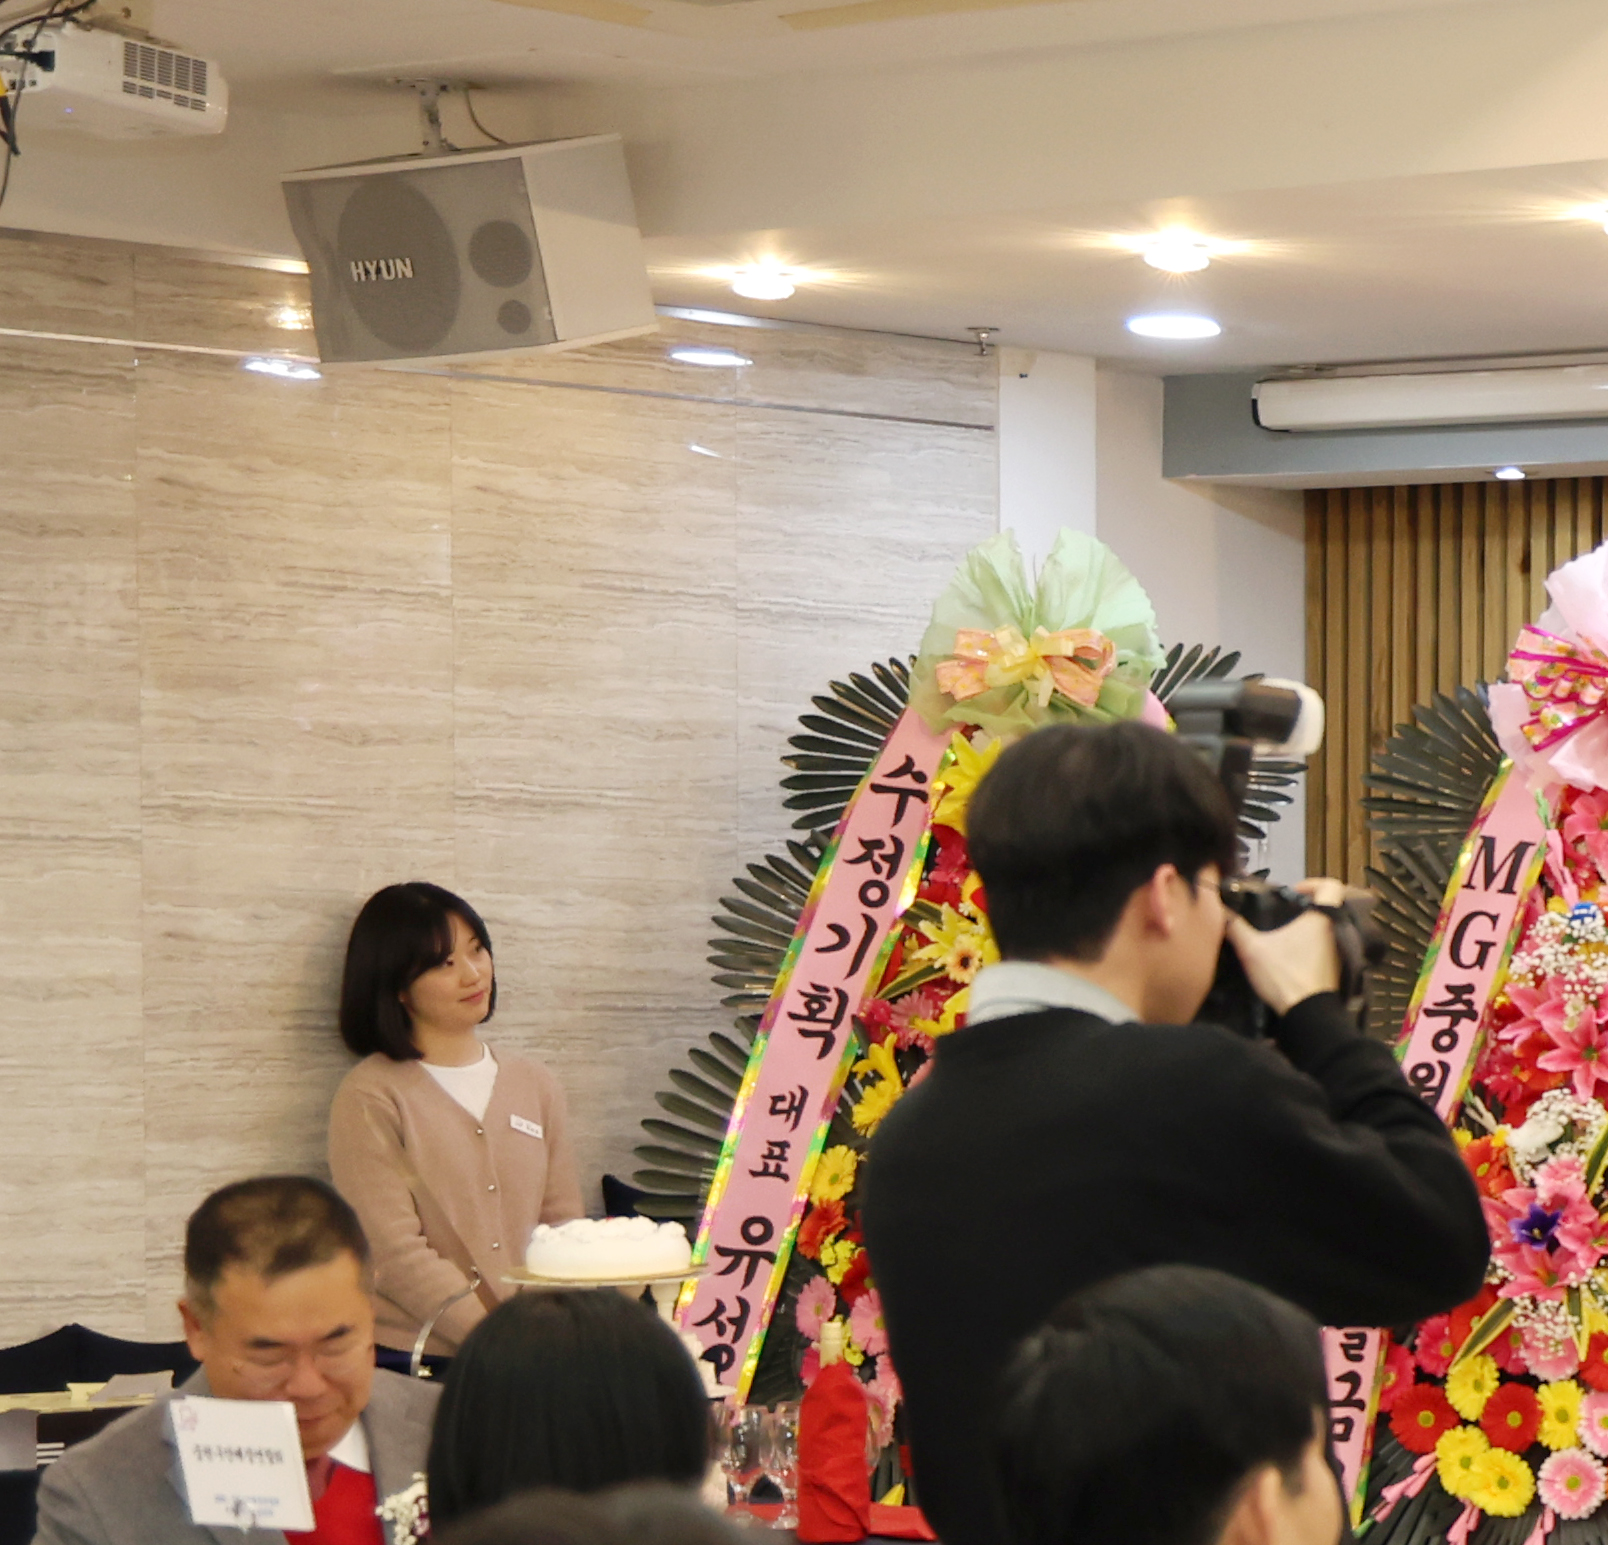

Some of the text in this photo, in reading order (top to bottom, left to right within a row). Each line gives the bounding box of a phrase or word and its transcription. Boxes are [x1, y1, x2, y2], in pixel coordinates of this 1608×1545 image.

[350, 257, 414, 282] HYUN
[787, 754, 930, 1061] 수정기획
[748, 1085, 810, 1183] 대표
